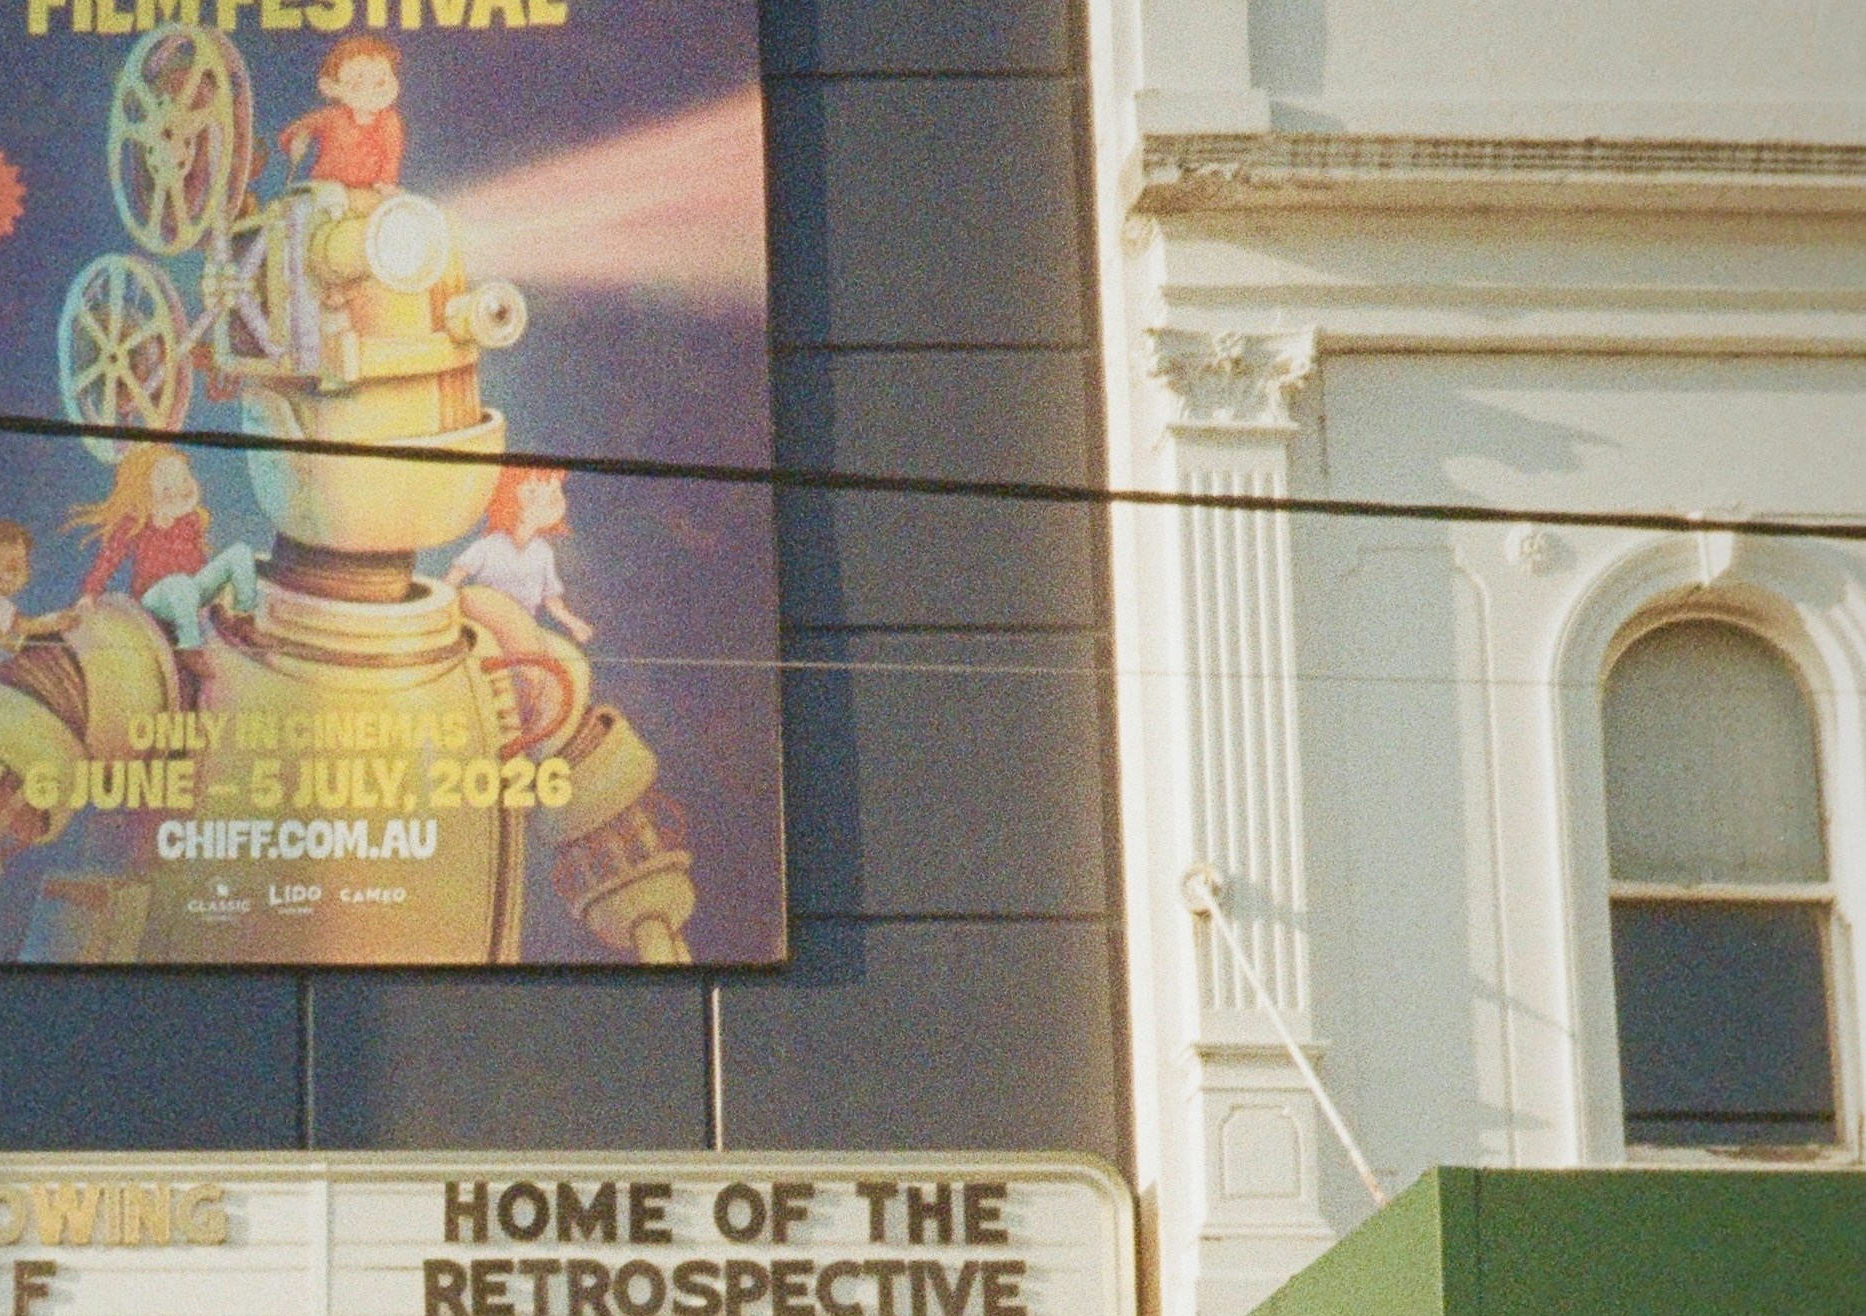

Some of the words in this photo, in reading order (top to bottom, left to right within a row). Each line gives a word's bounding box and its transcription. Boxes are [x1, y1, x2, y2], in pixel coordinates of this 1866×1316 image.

[127, 711, 229, 749] ONLY
[236, 711, 281, 749] IN
[286, 710, 469, 749] CINEMAS
[23, 760, 62, 809] 6
[67, 758, 195, 809] JUNE
[250, 758, 283, 809] 5
[294, 757, 417, 813] JULY,
[429, 757, 574, 808] 2026
[156, 818, 438, 860] CHIFF.COM.AU
[187, 899, 251, 913] CLASSIC
[268, 884, 323, 906] LIDO
[339, 886, 408, 904] CAMEO
[444, 1181, 673, 1245] HOME
[713, 1181, 816, 1245] OF
[856, 1182, 1009, 1245] THE
